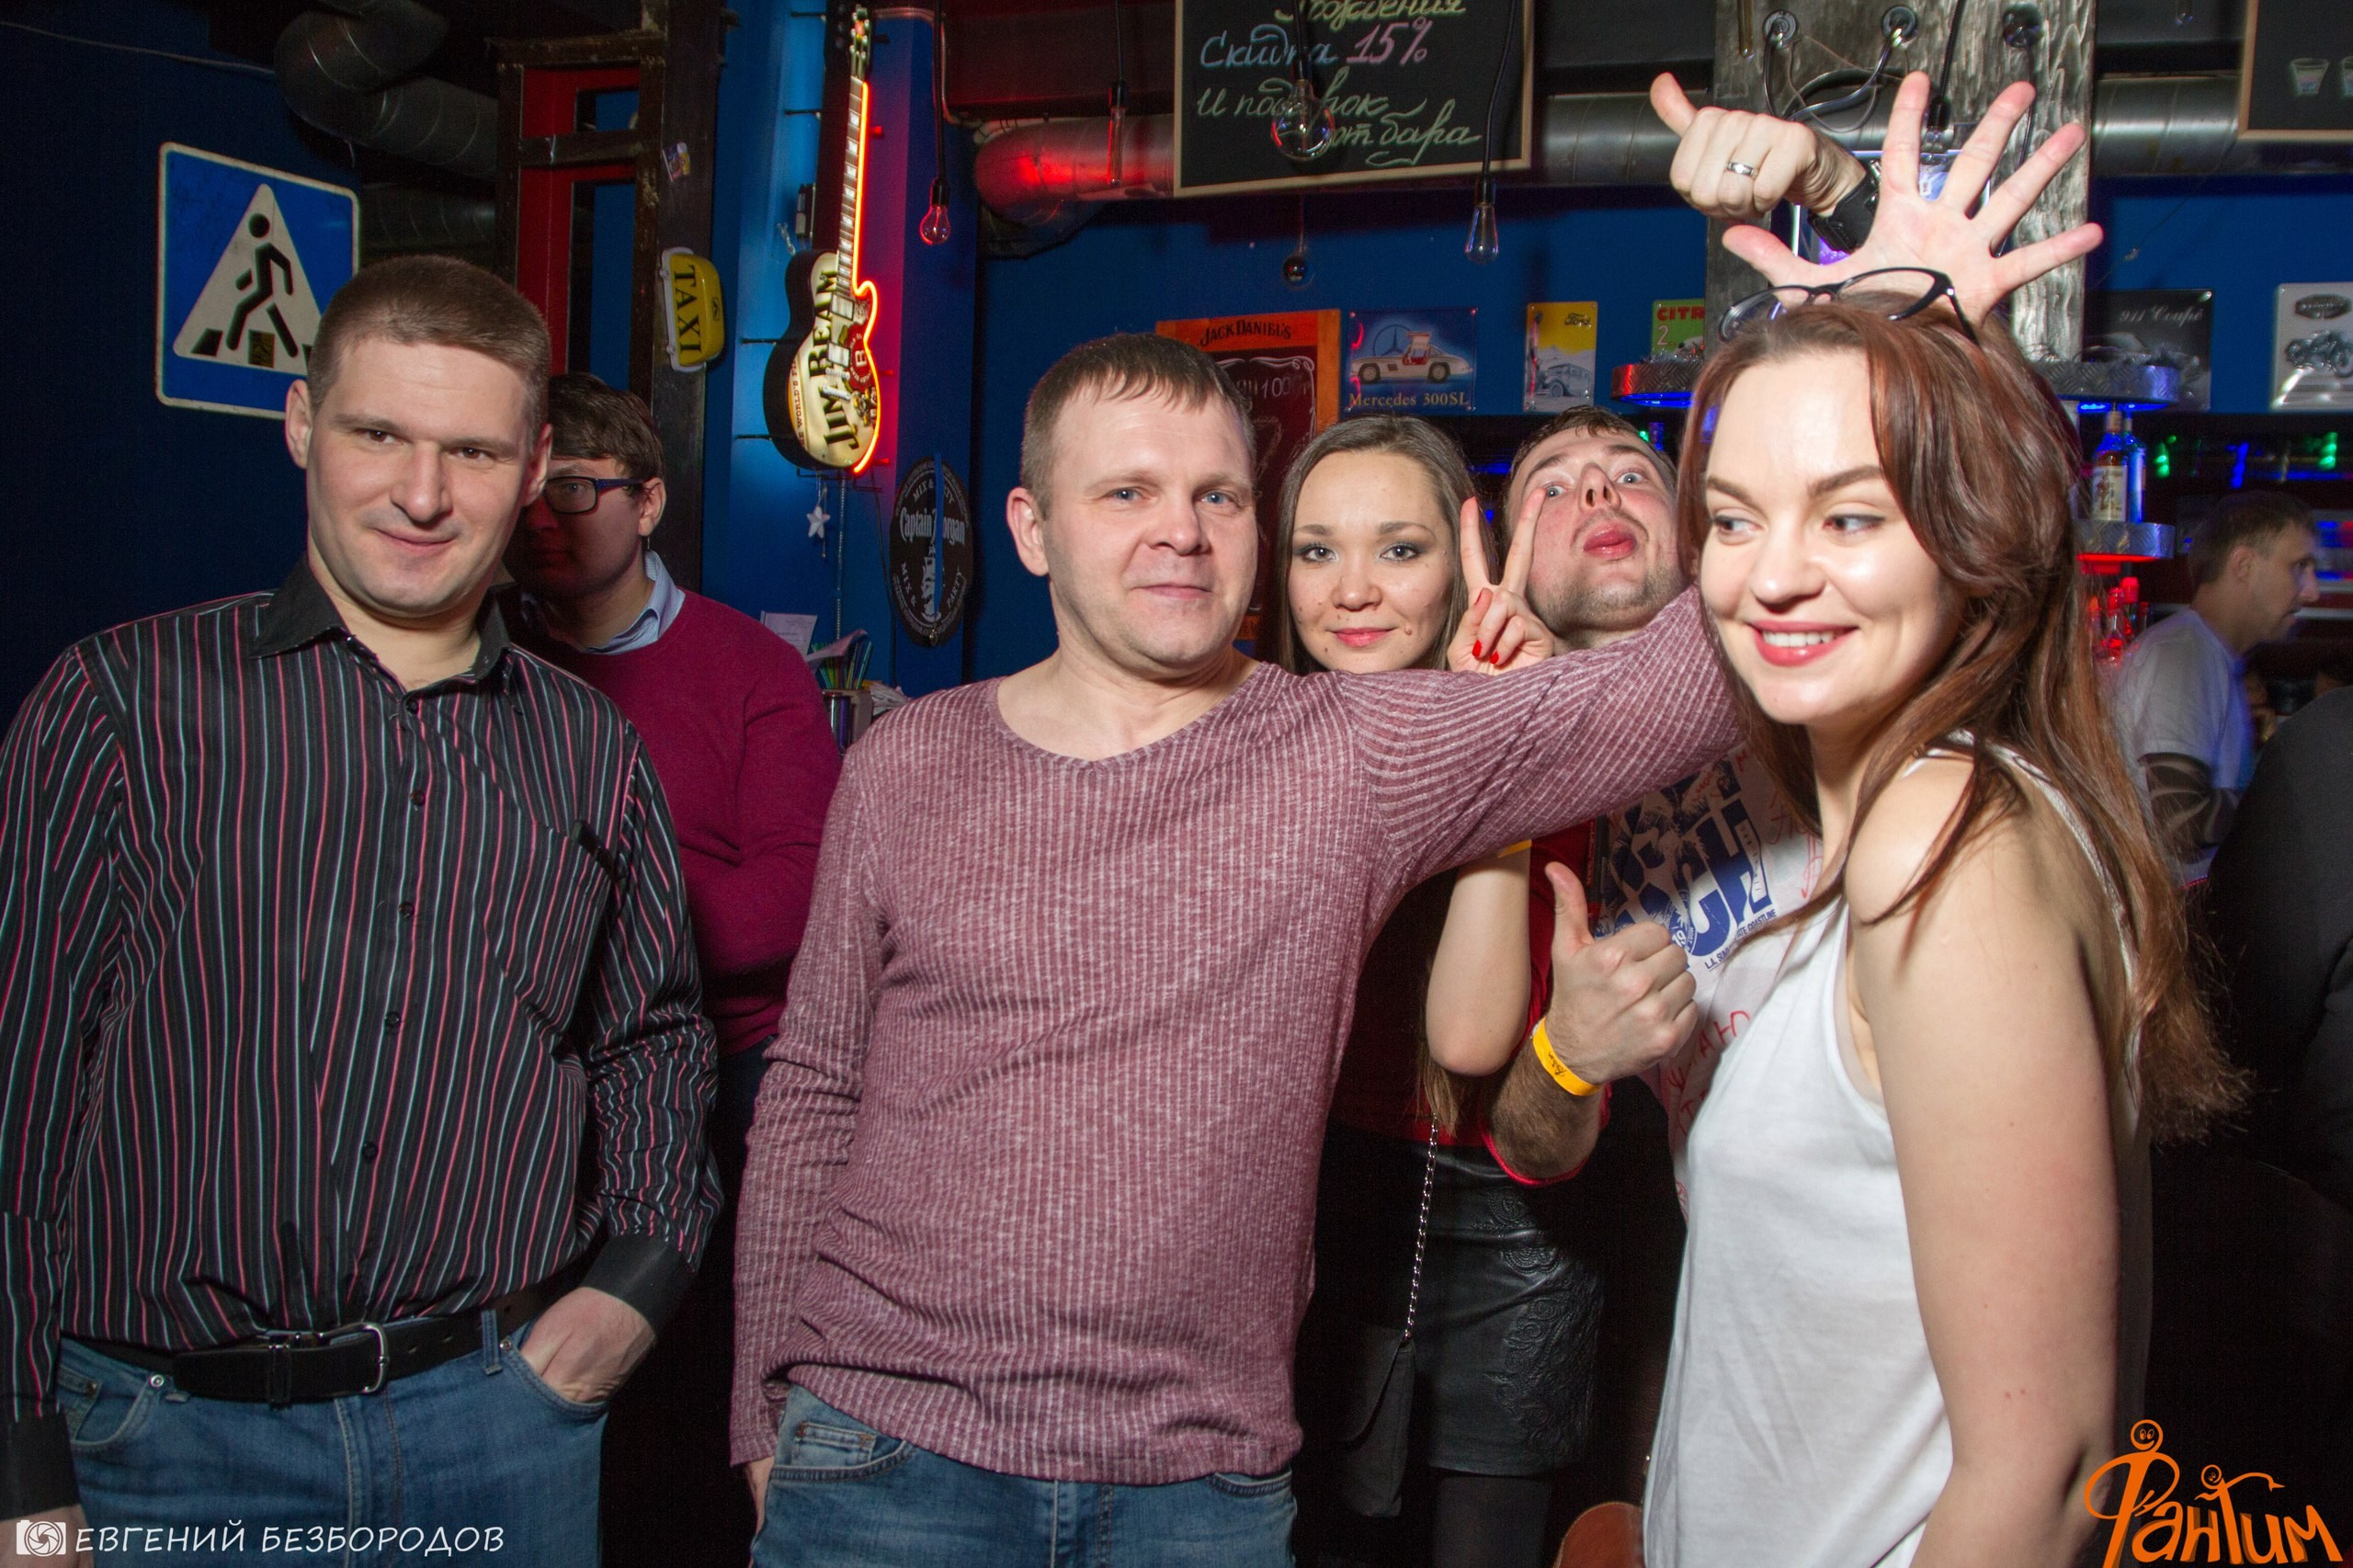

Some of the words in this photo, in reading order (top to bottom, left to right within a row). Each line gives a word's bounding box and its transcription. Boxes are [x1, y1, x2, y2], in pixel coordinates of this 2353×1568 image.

[1346, 17, 1433, 65] 15%
[1367, 97, 1483, 165] бара
[674, 264, 701, 353] TAXI
[808, 269, 838, 378] BEAM
[1199, 324, 1234, 347] JACK
[1236, 319, 1291, 339] DANIEL'S
[818, 381, 860, 450] JIM
[1349, 392, 1417, 406] Mercedes
[1423, 390, 1470, 406] 300SL
[900, 506, 932, 543] Captain
